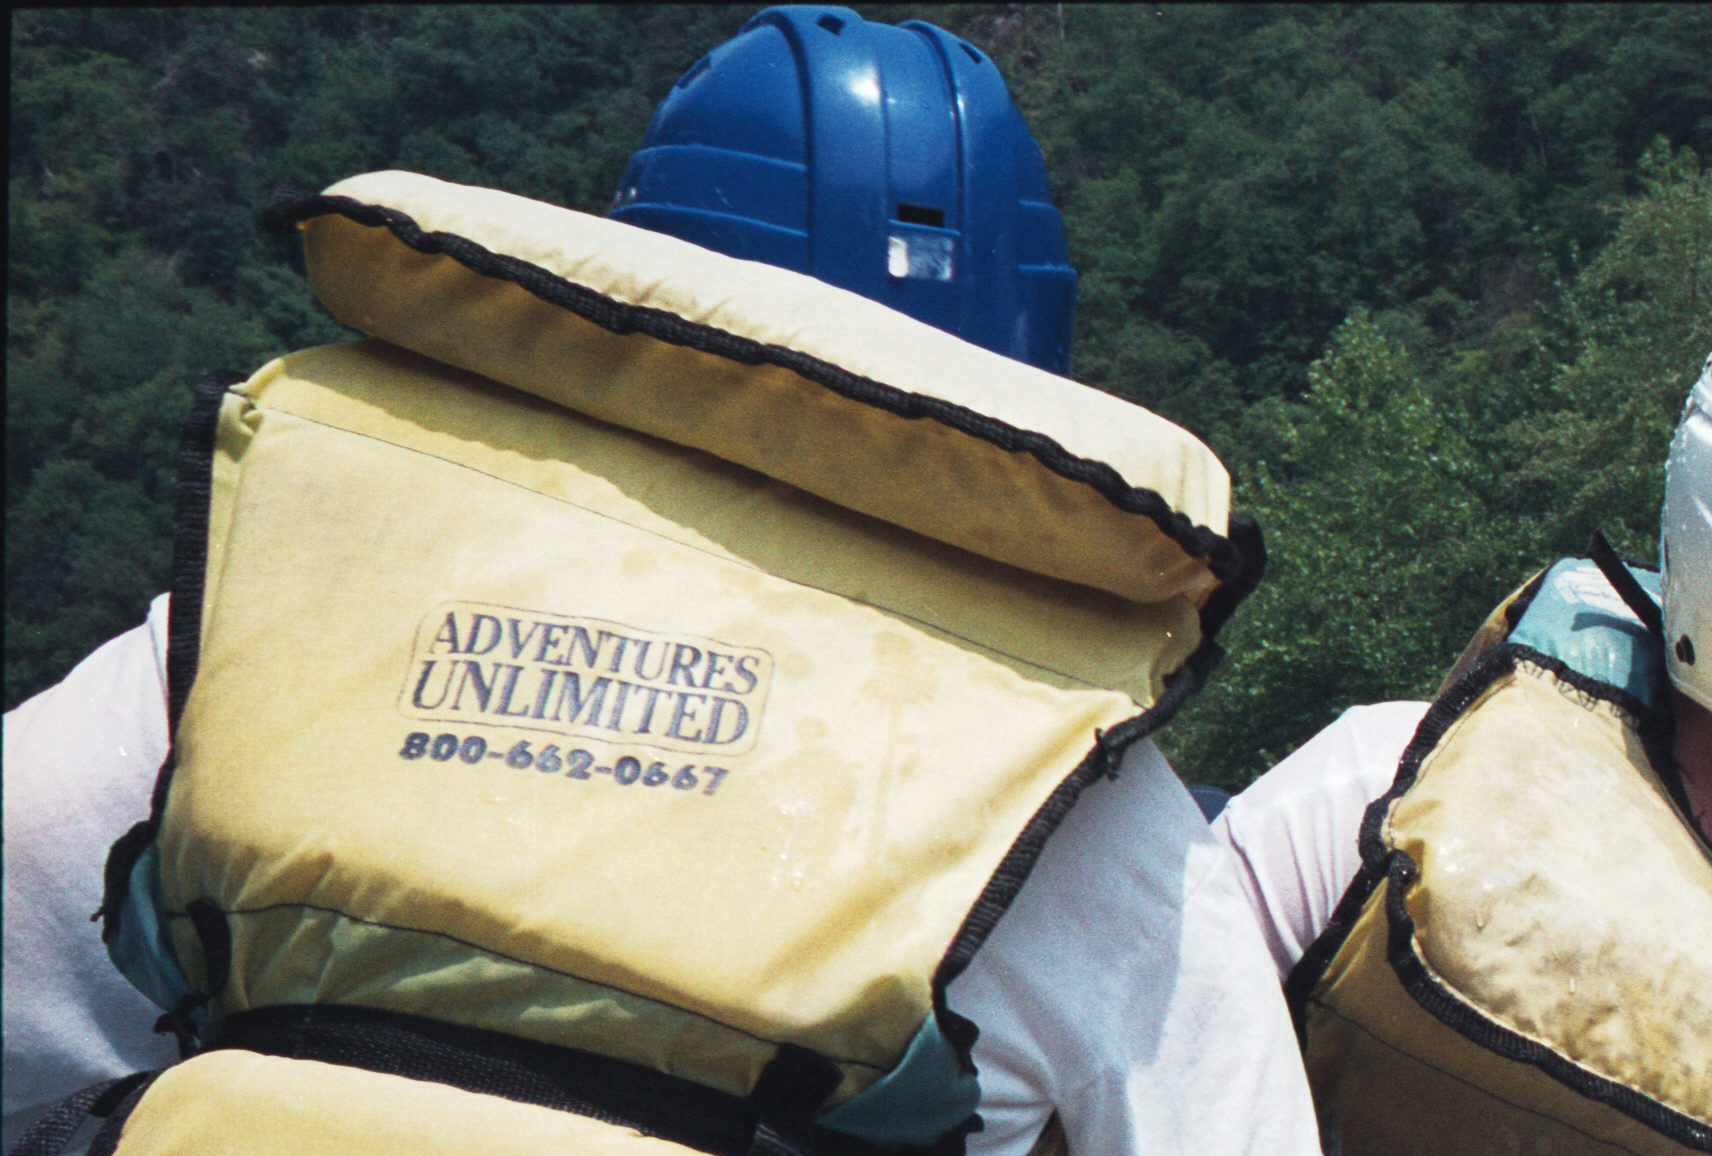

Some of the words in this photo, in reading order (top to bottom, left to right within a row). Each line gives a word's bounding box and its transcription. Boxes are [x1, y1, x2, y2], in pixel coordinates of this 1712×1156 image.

[428, 610, 761, 695] ADVENTURES
[411, 659, 750, 745] UNLIMITED
[399, 731, 730, 796] 800-662-0667
